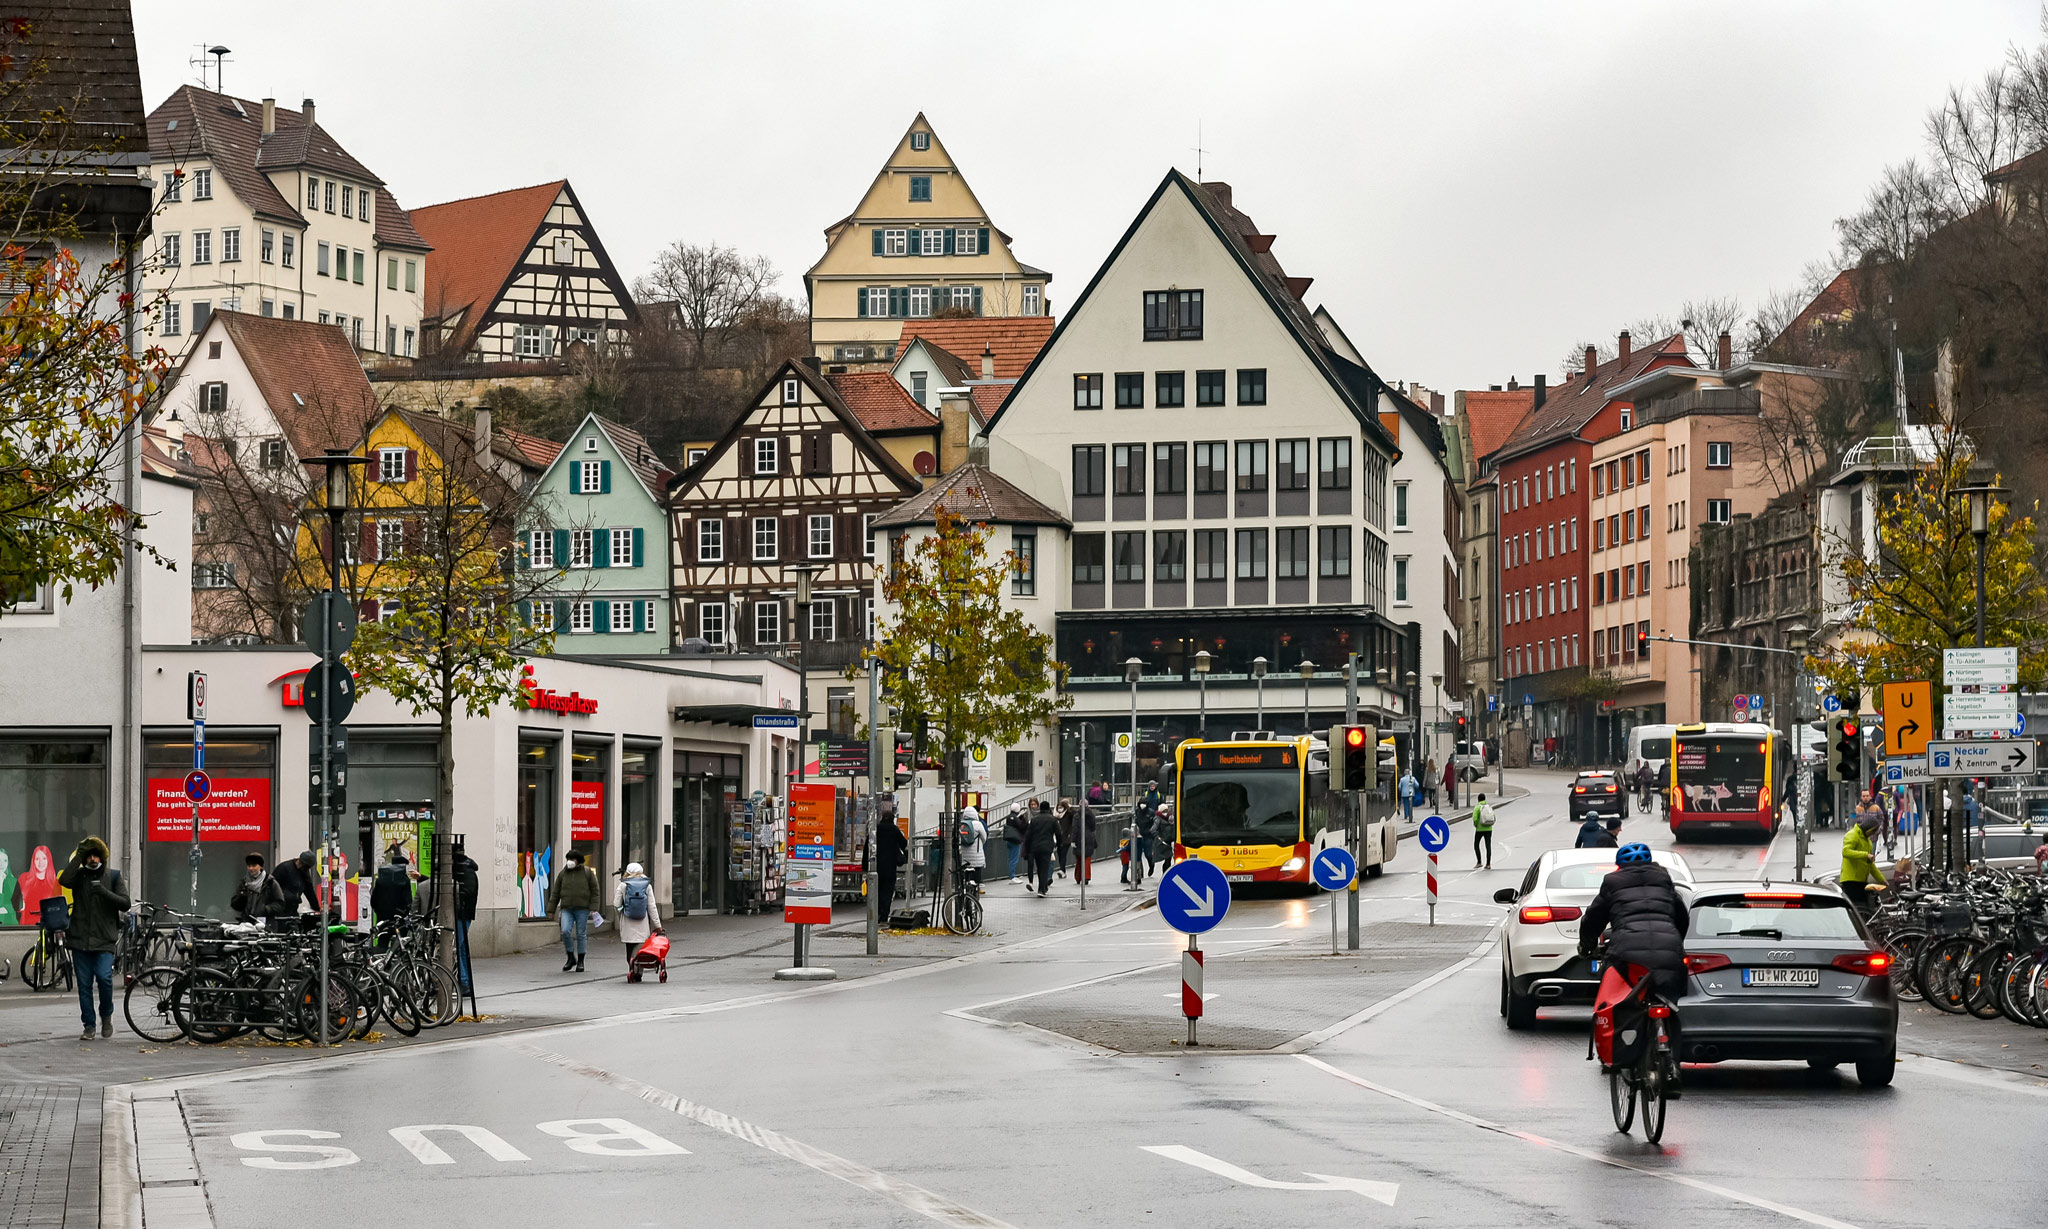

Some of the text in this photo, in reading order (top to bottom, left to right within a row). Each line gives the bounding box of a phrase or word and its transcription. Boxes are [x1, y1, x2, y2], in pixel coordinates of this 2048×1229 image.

[538, 688, 598, 716] Kreissparkasse
[1901, 692, 1913, 708] U
[756, 718, 795, 726] Uhlandstraße
[1954, 747, 1989, 756] Neckar
[1196, 752, 1262, 766] 1 Hauptbahnhof
[1966, 759, 1998, 767] Zentrum
[1903, 767, 1928, 776] Necka
[211, 789, 248, 798] werden?
[170, 801, 186, 809] geht
[229, 800, 256, 808] einfach!
[1232, 847, 1259, 855] TüBus
[1750, 969, 1817, 982] TÜ WR 2010
[229, 1118, 694, 1170] BUS
